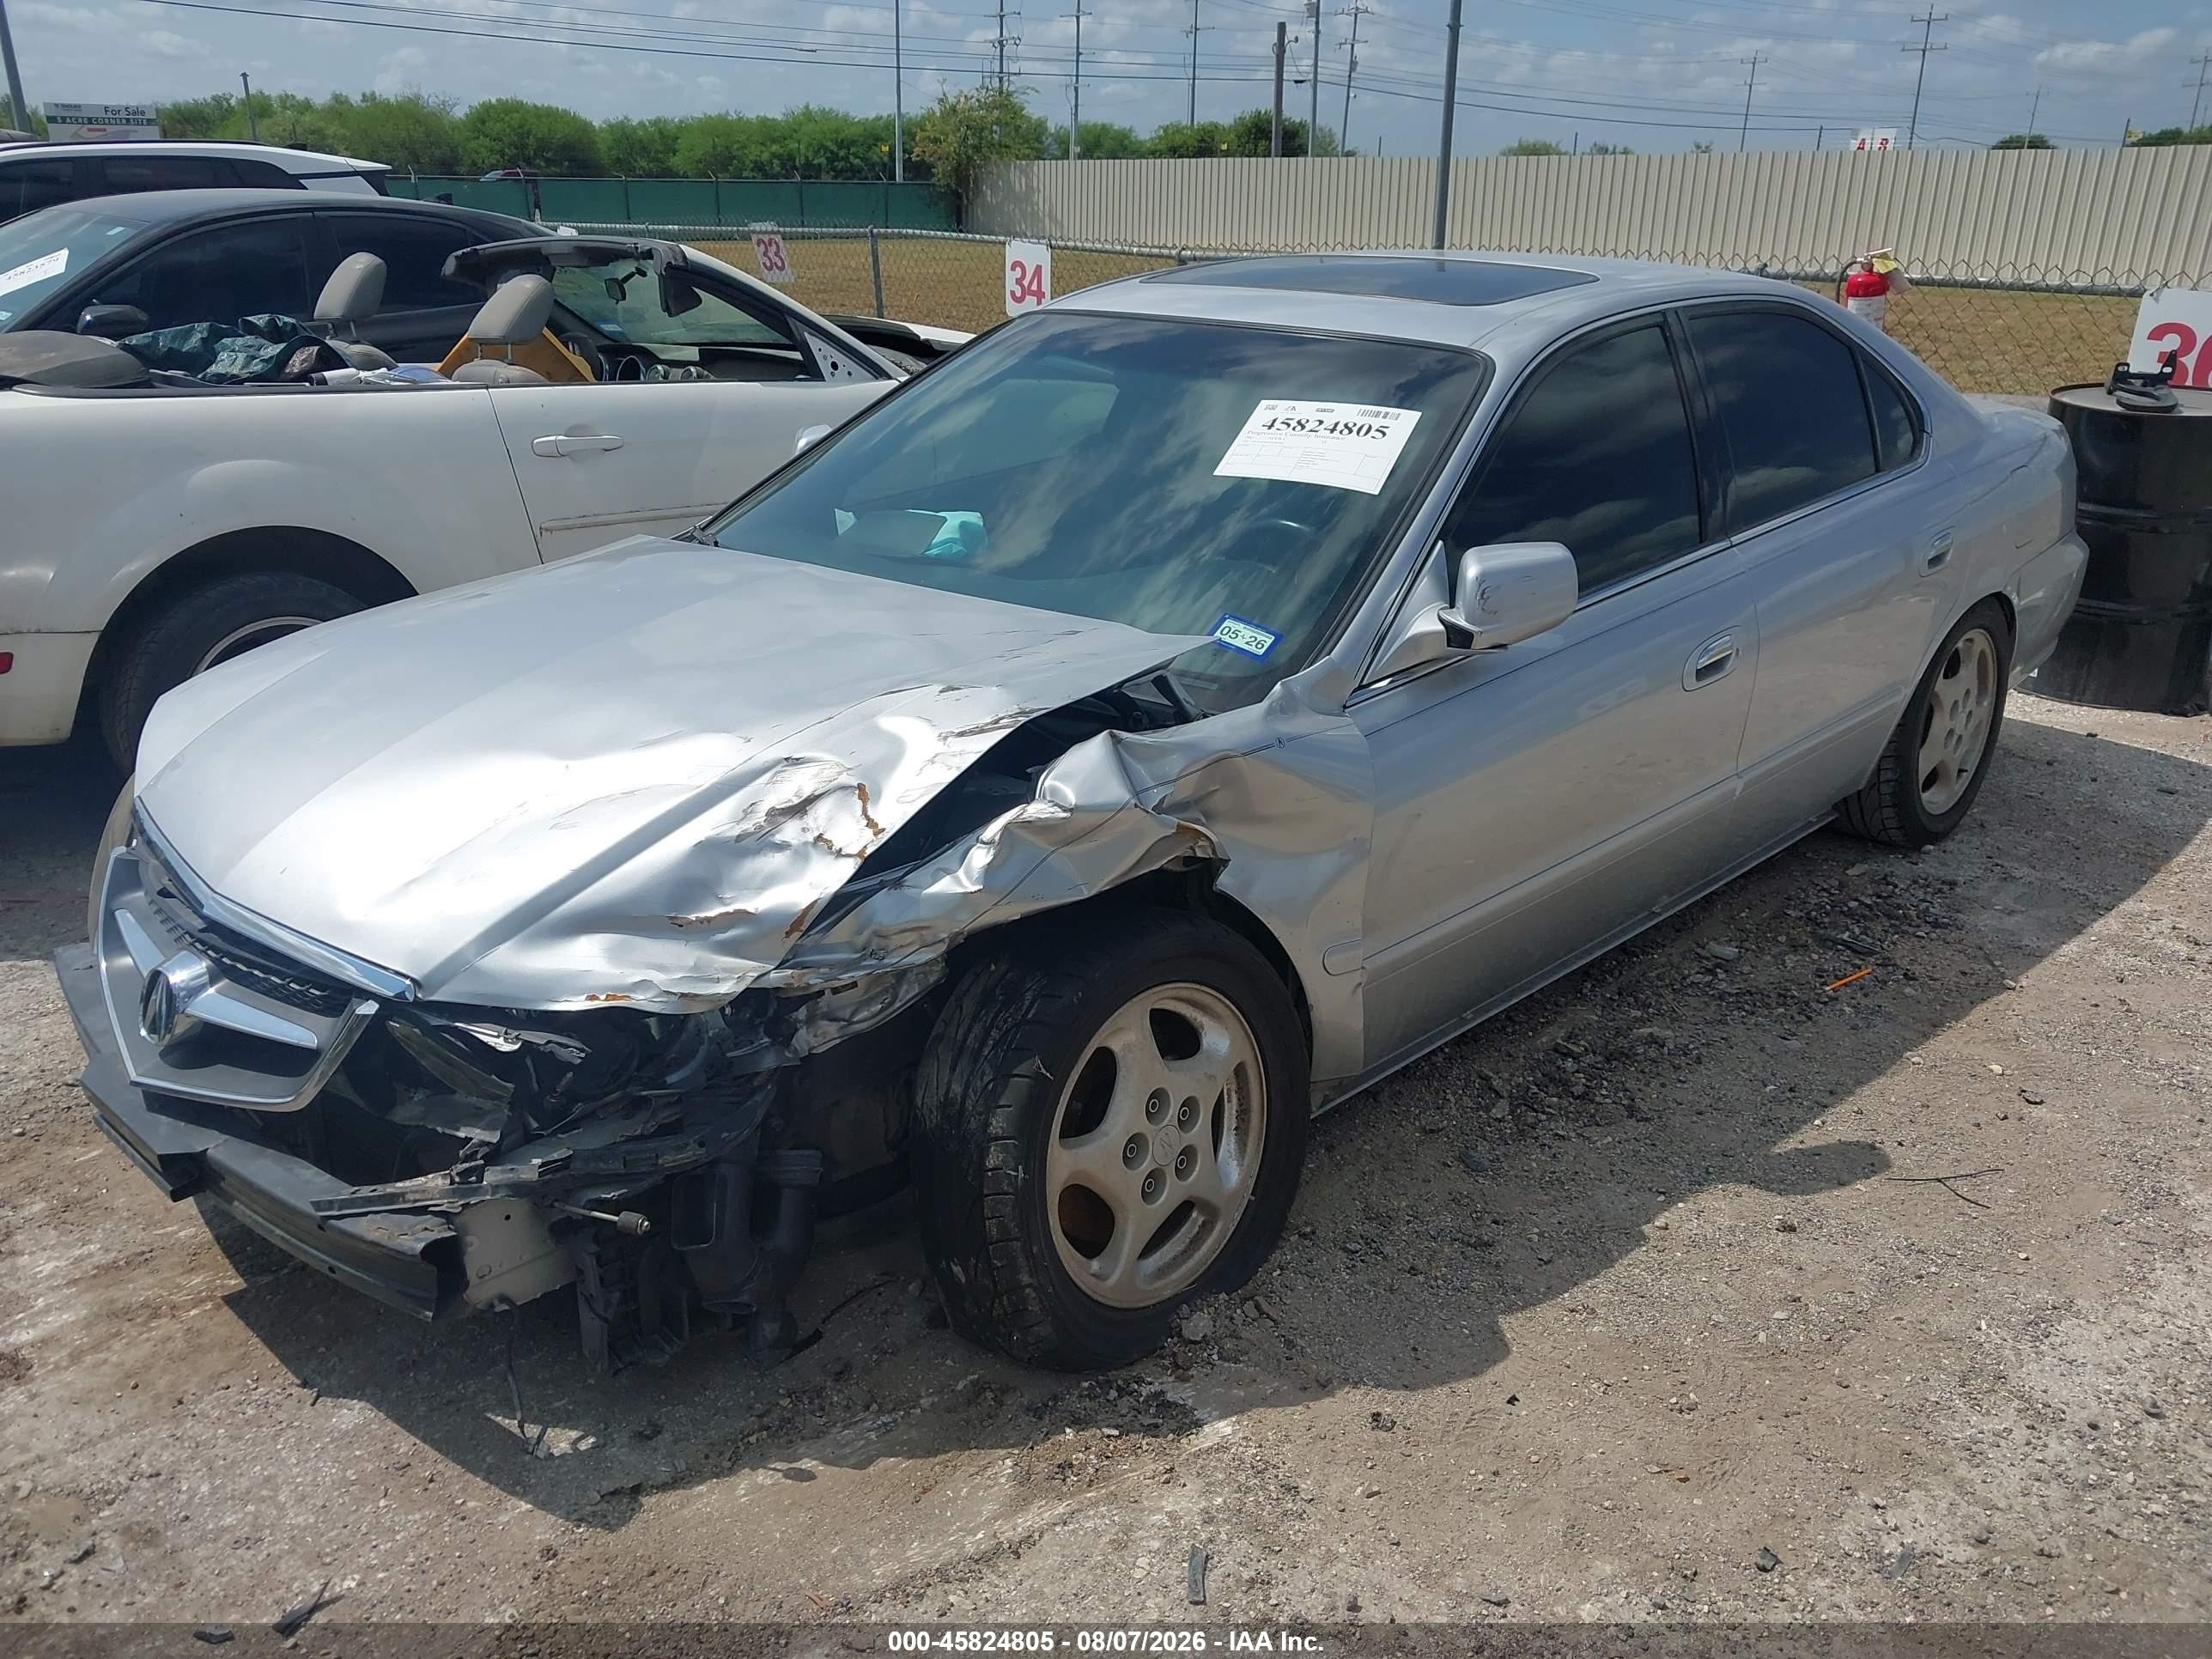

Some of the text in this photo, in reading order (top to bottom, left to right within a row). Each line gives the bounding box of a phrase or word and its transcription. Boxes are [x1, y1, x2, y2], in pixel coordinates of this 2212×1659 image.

[104, 106, 146, 117] For Sale
[1856, 137, 1866, 150] A
[757, 237, 786, 272] 33
[1010, 260, 1045, 307] 34
[1261, 417, 1390, 440] 45824805
[1219, 625, 1242, 640] 05
[1243, 635, 1267, 650] 26
